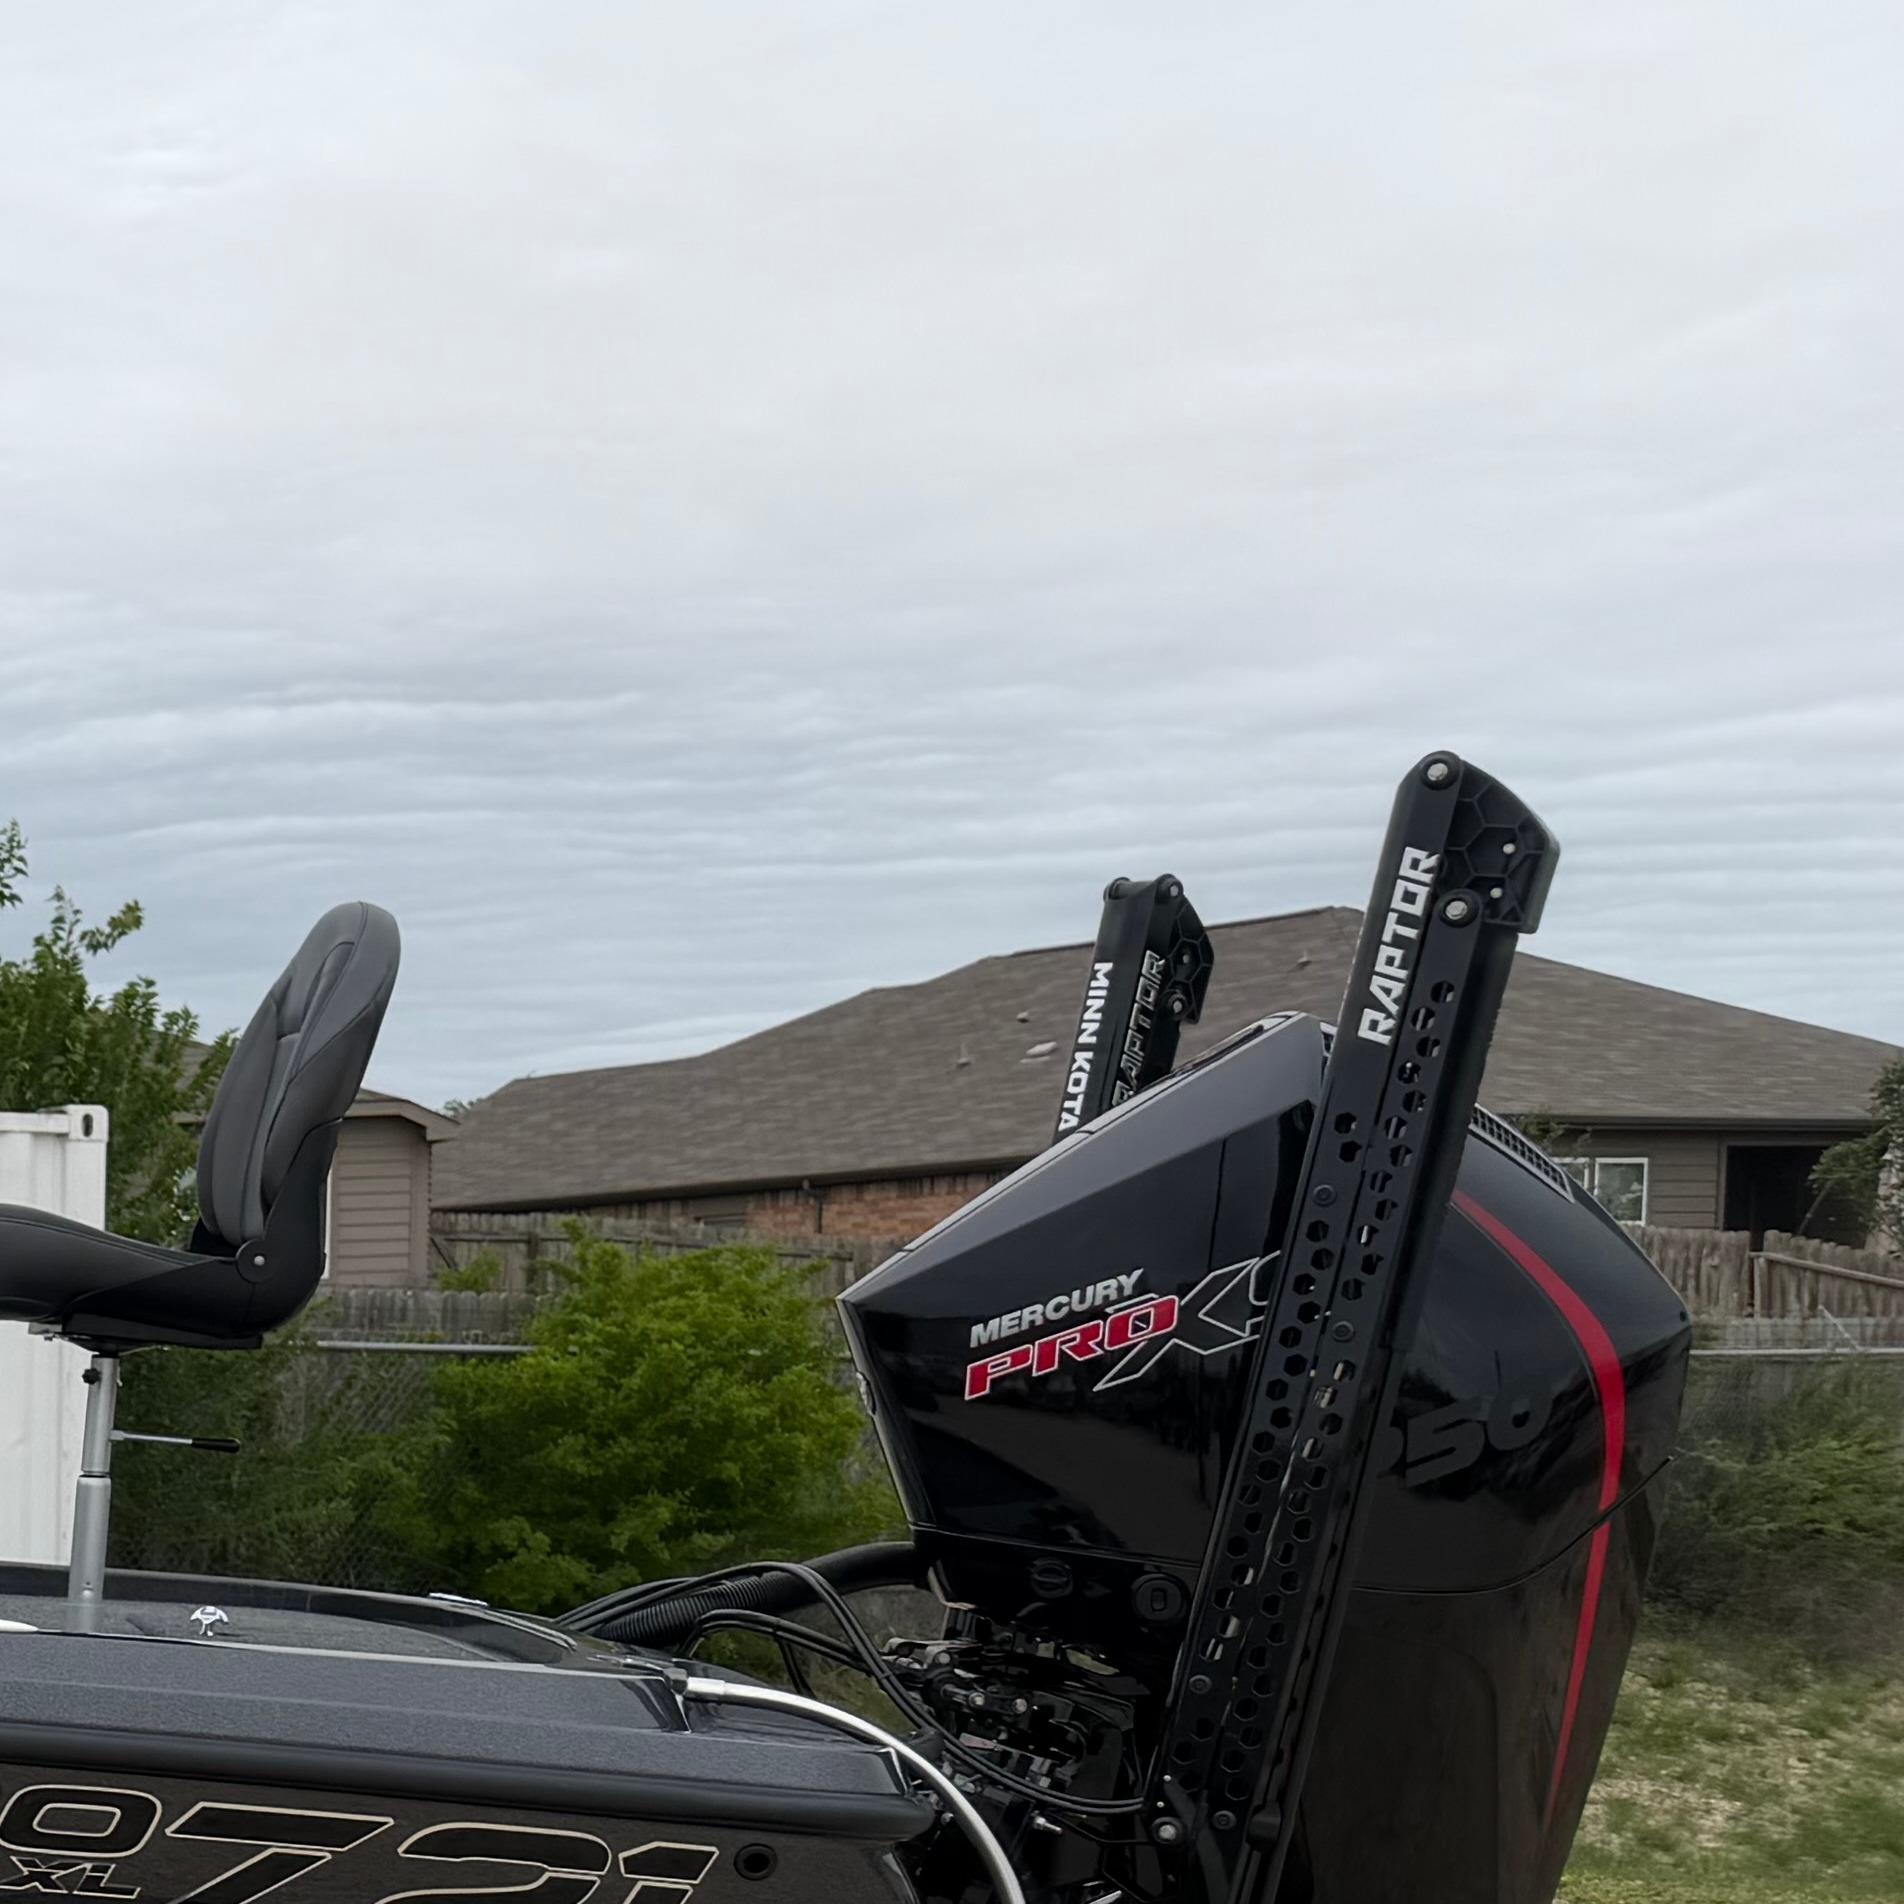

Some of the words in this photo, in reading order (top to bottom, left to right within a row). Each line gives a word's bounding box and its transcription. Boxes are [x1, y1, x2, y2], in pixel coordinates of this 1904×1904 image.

[1357, 846, 1441, 1046] RAPTOR
[1078, 961, 1114, 1044] MINN
[1111, 949, 1166, 1107] RAPTOR
[1058, 1050, 1094, 1132] KOTA
[964, 1295, 1180, 1401] PRO
[969, 1267, 1145, 1348] MERCURY
